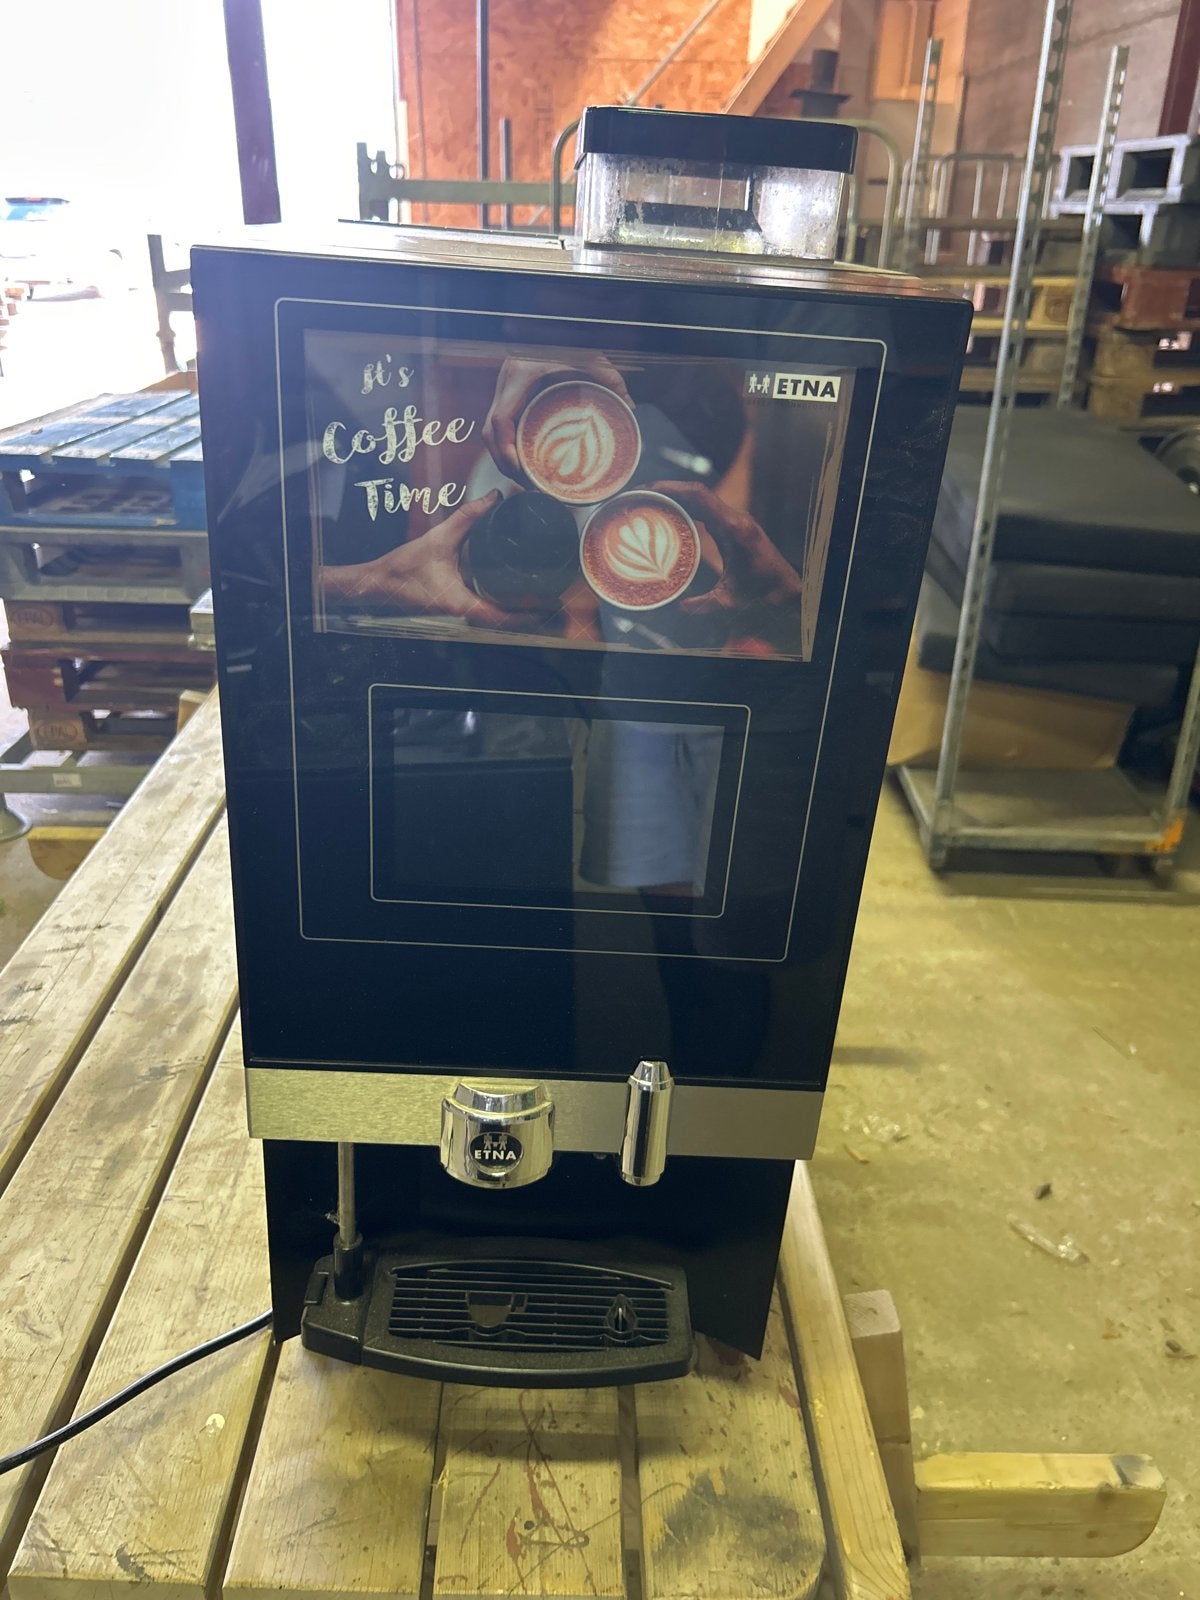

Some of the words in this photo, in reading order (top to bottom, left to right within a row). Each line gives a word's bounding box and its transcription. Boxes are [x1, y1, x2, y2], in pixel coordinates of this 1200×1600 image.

[777, 378, 836, 398] ETNA
[323, 405, 475, 465] Coffee
[354, 477, 466, 522] Time
[474, 1149, 517, 1160] ETNA
